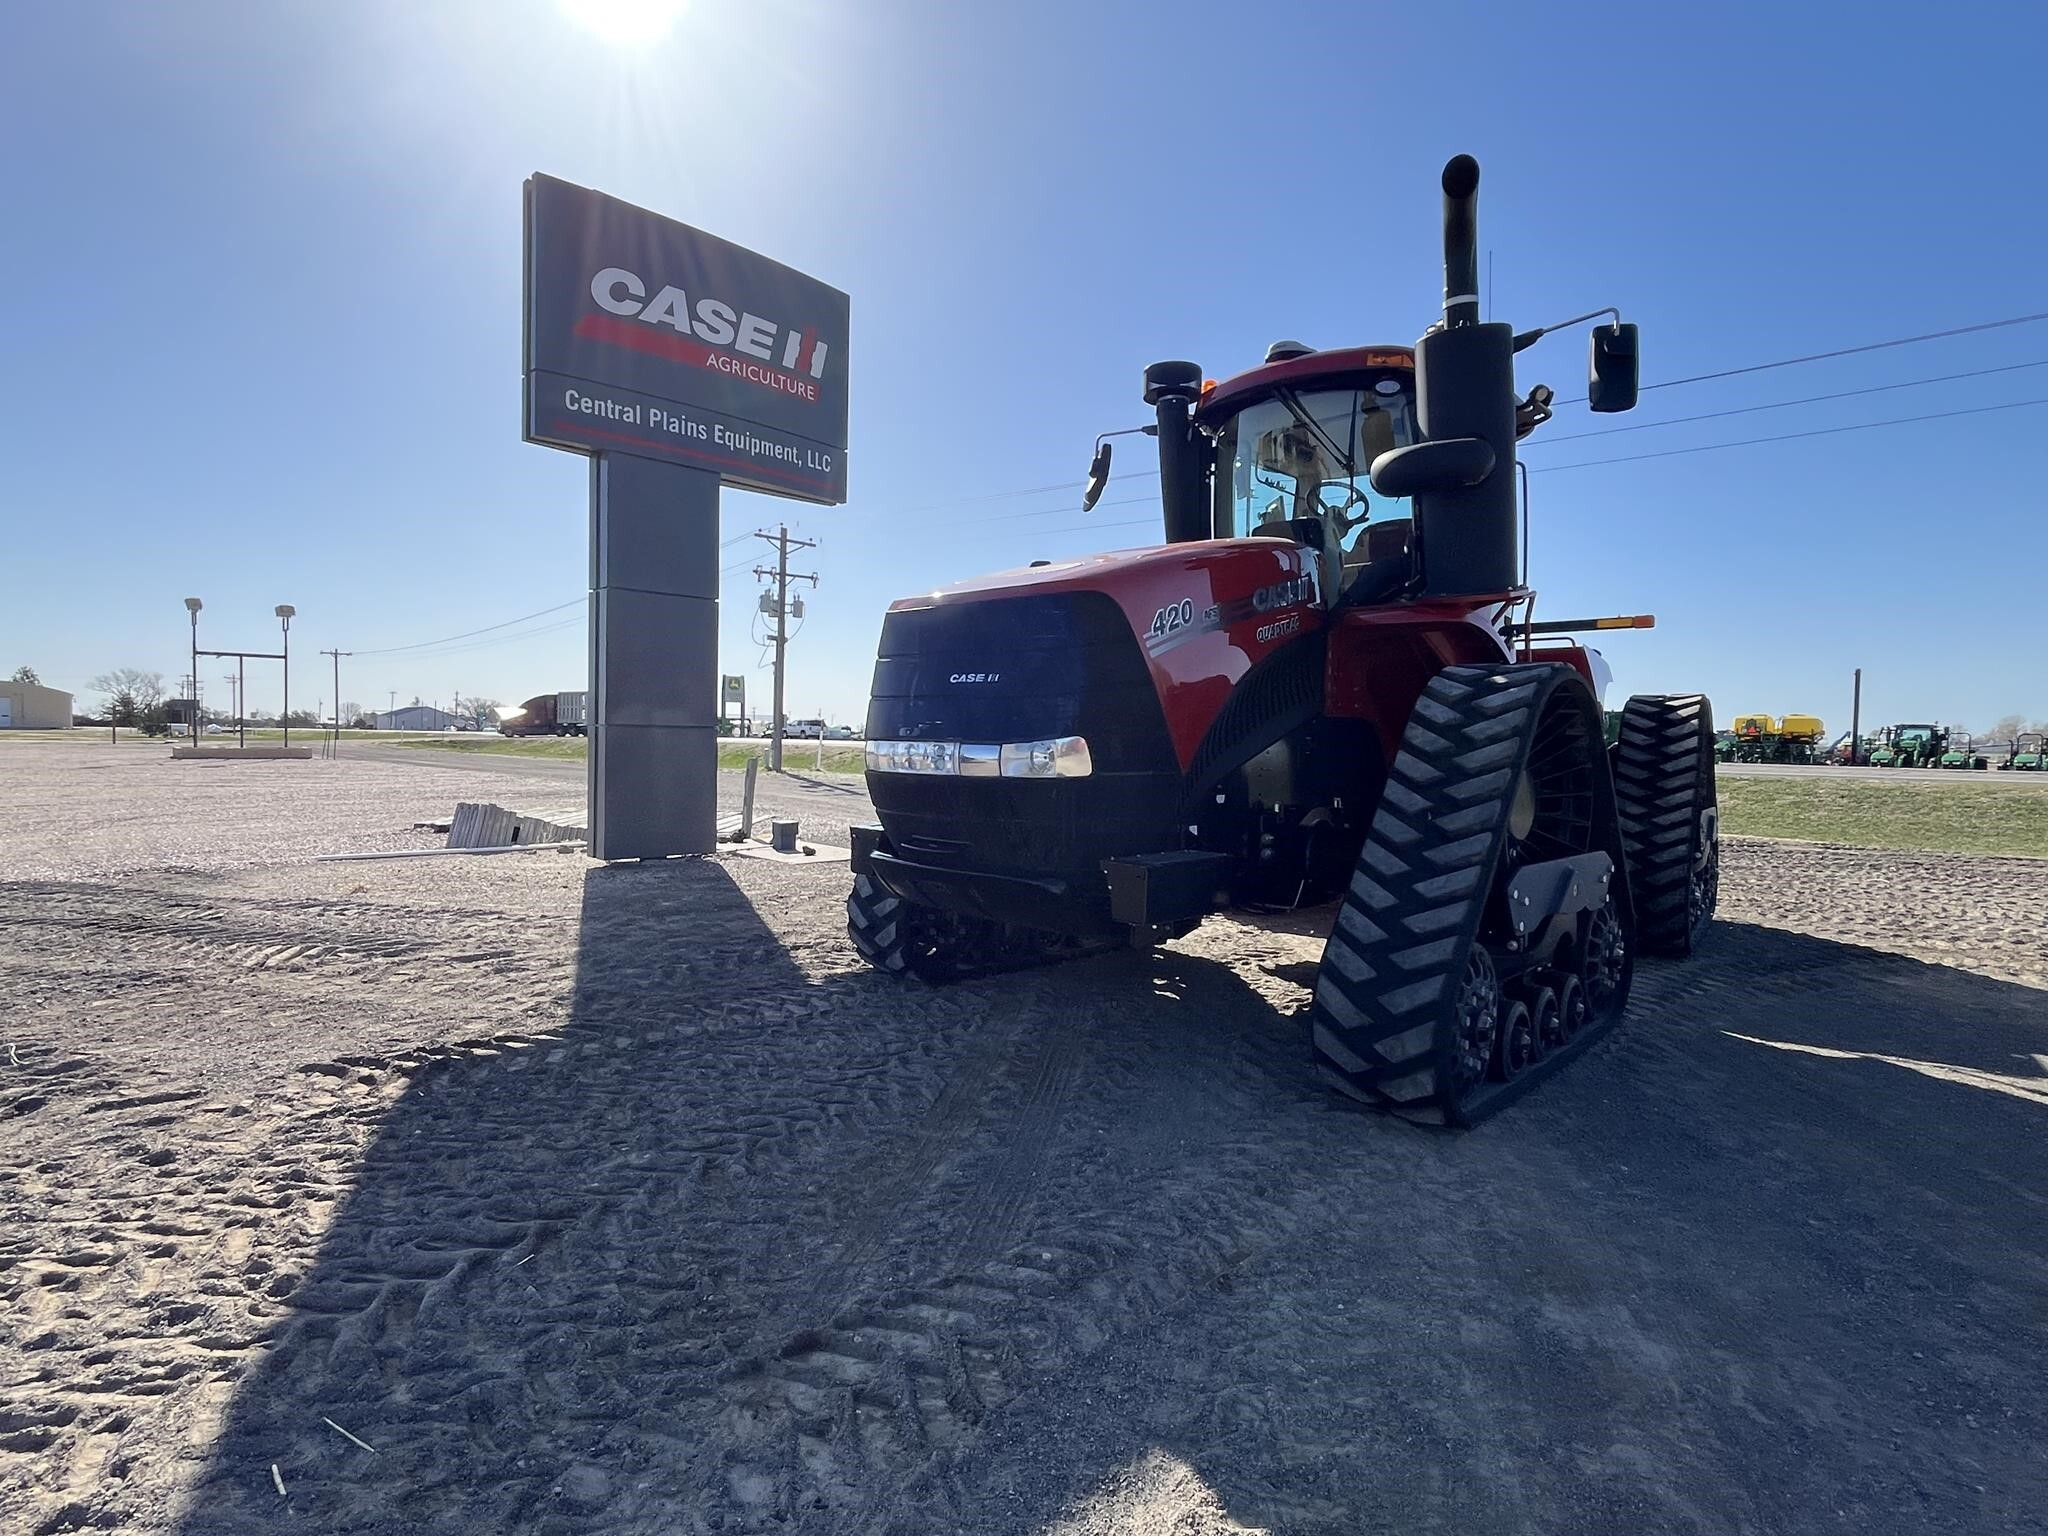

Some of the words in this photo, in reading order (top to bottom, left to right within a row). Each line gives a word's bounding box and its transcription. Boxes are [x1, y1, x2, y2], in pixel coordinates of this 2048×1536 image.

[590, 267, 778, 361] CASE
[705, 352, 816, 401] AGRICULTURE
[564, 388, 642, 426] Central
[650, 408, 708, 441] Plains
[714, 425, 803, 467] Equipment,
[807, 450, 832, 472] LLC
[1151, 597, 1194, 638] 420
[950, 673, 985, 683] CASE
